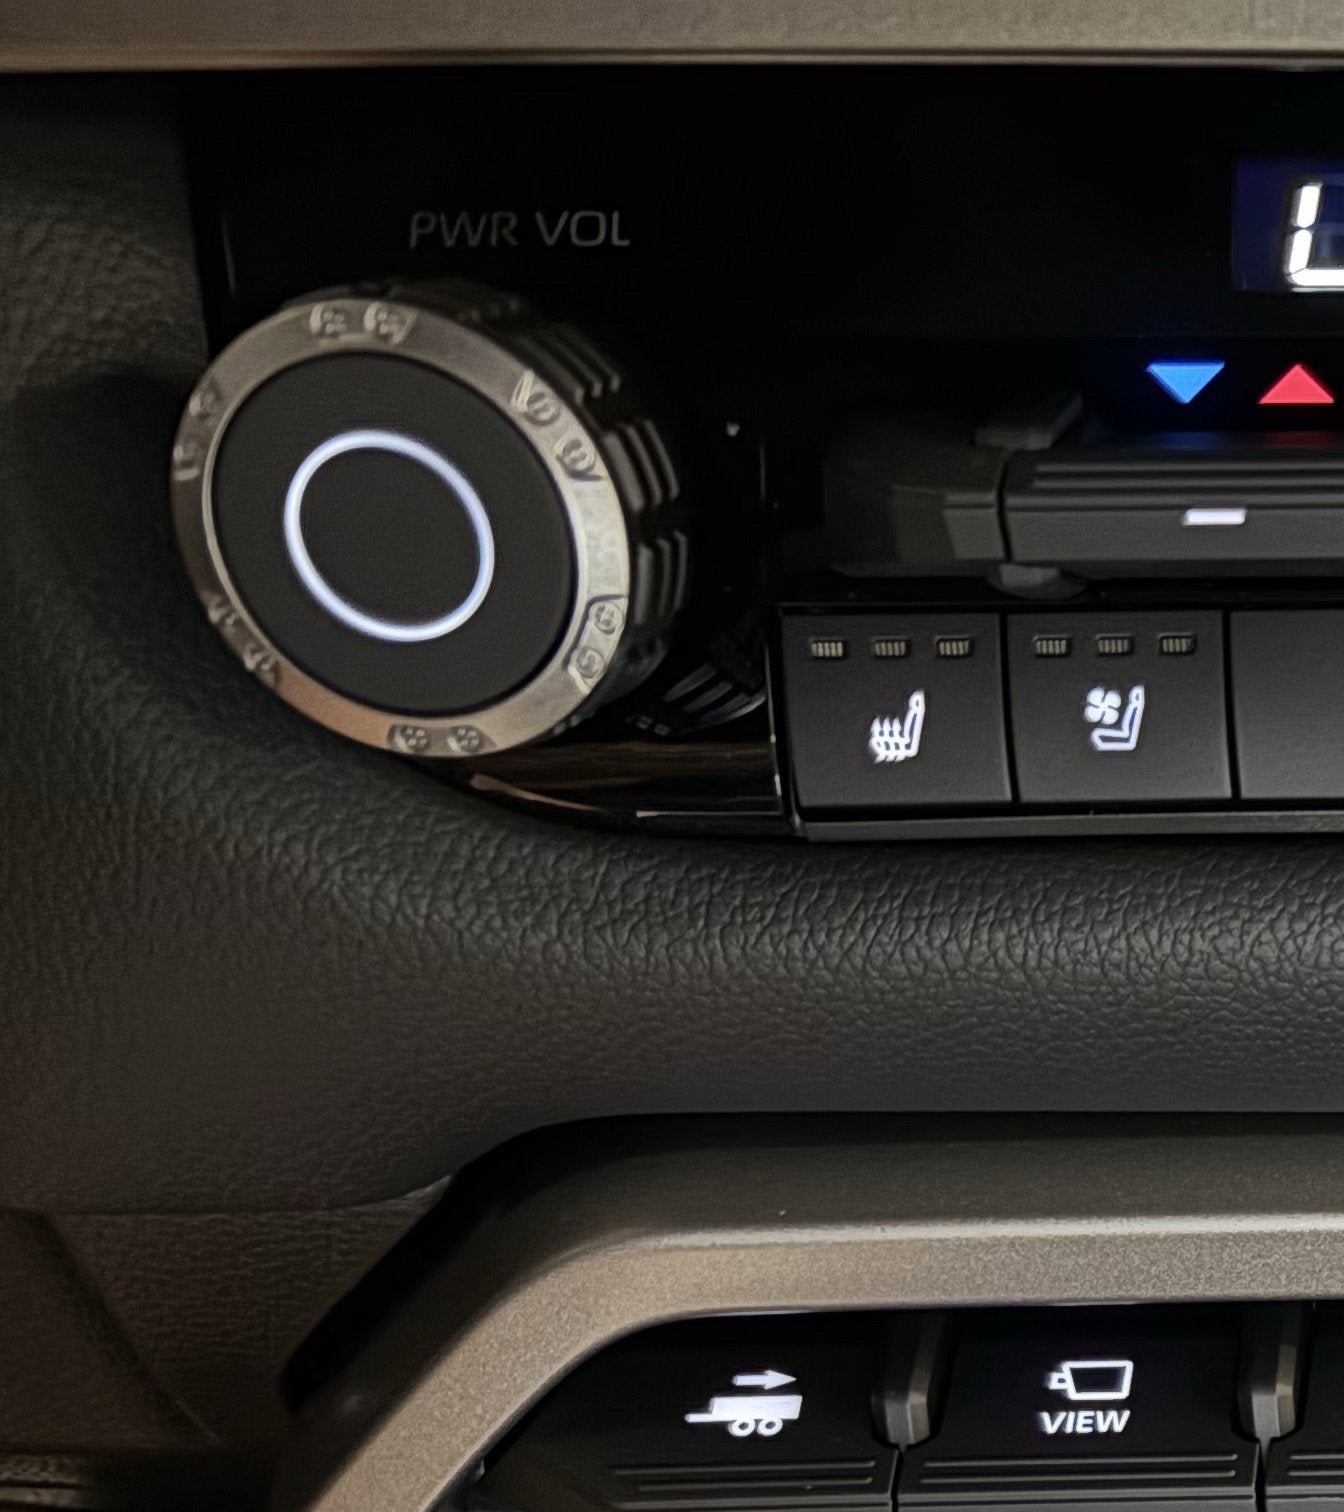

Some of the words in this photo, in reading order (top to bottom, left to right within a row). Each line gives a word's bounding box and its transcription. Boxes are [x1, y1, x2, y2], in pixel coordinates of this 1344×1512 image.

[408, 211, 519, 248] PWR
[534, 210, 631, 247] VOL
[1038, 1409, 1131, 1435] VIEW
